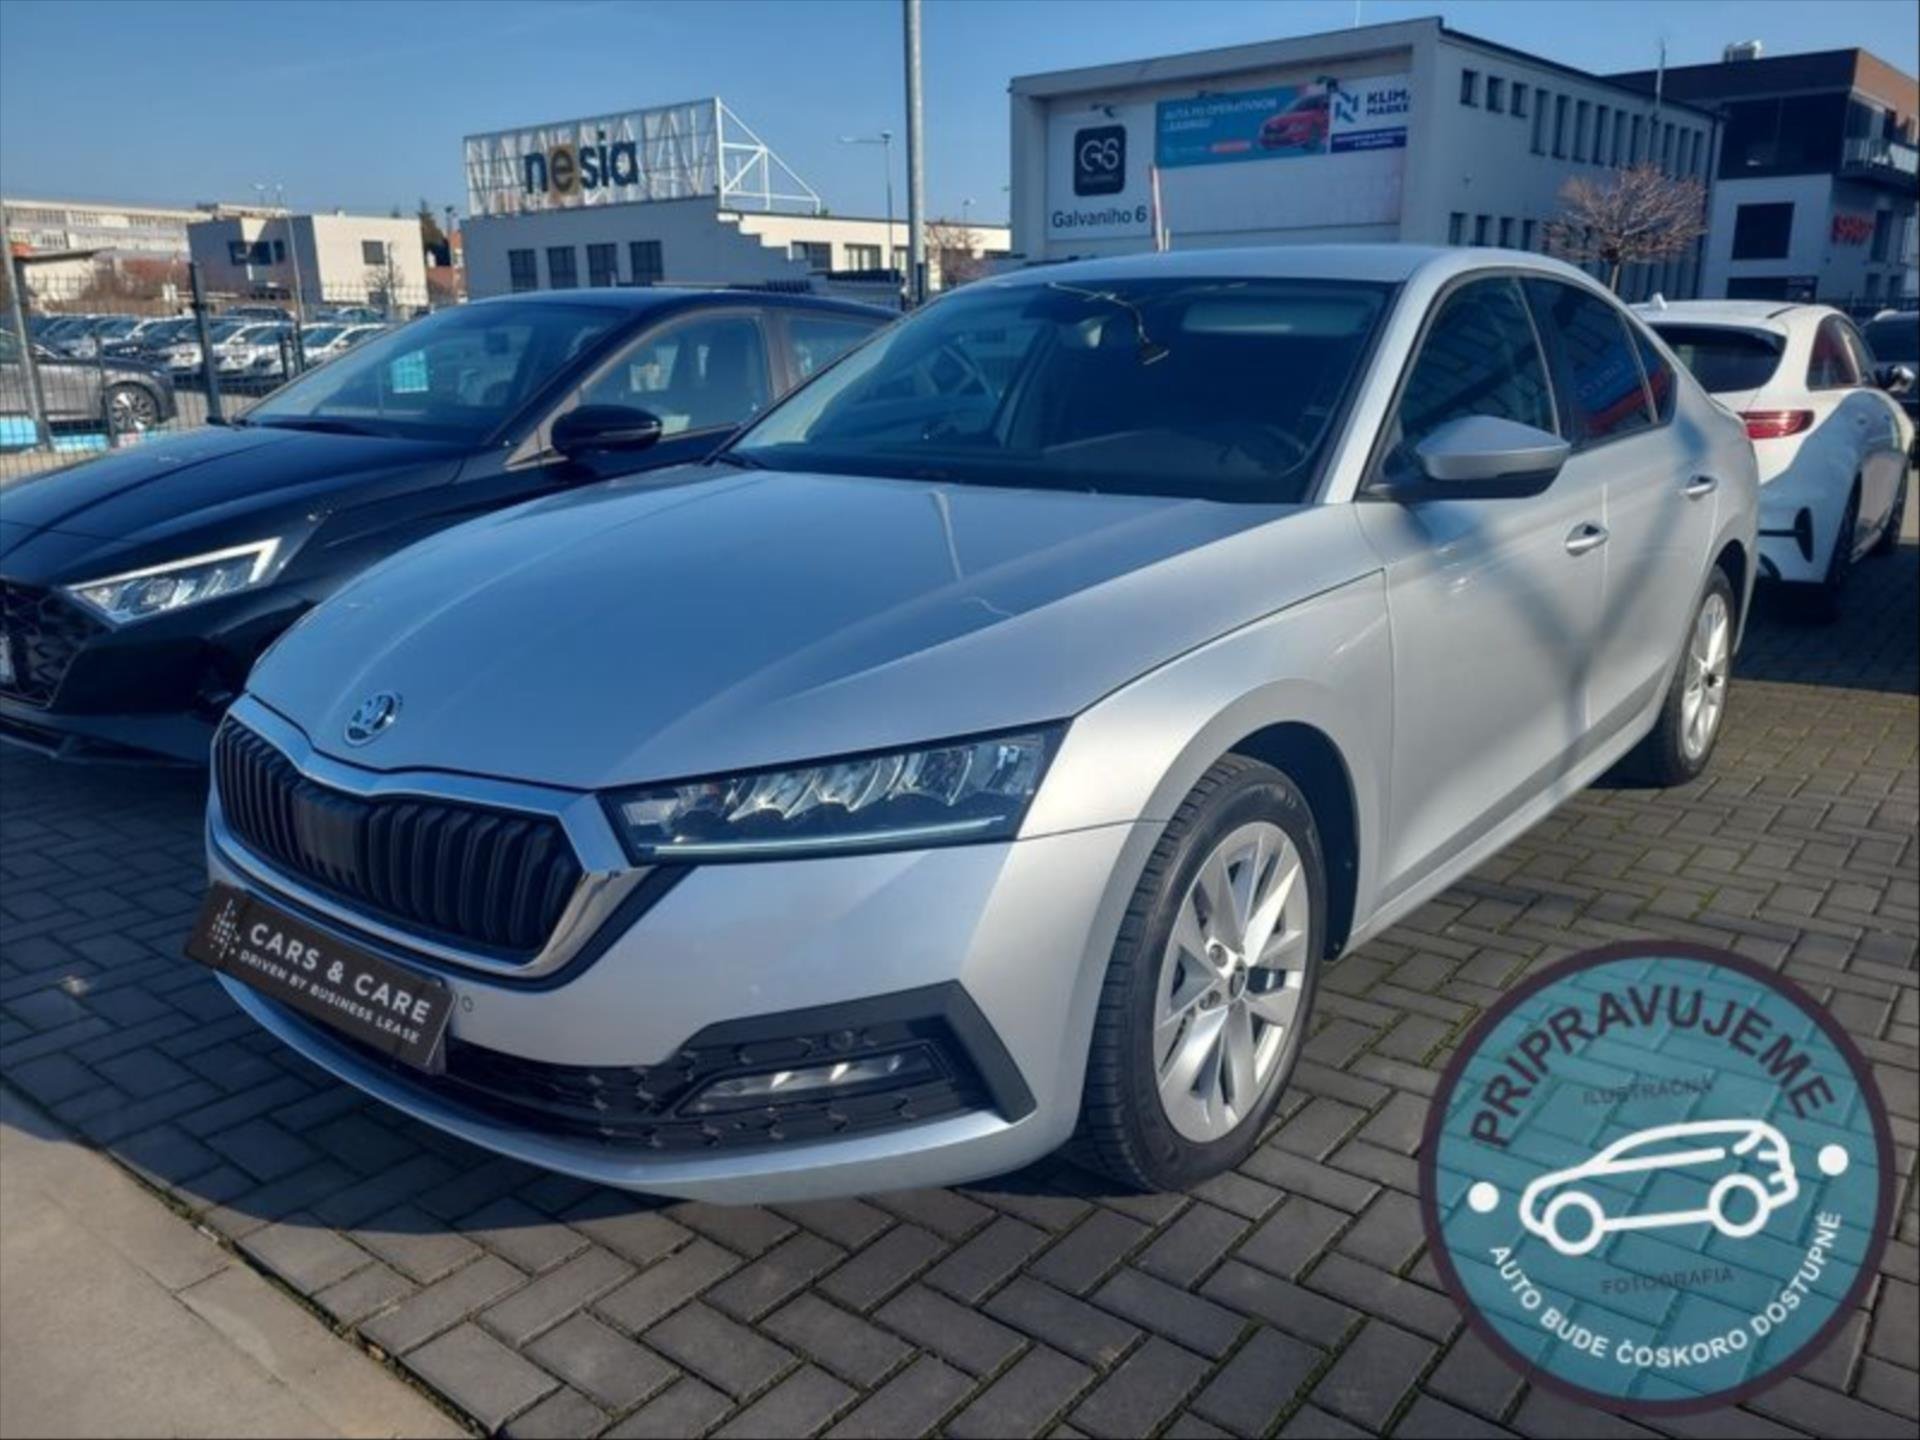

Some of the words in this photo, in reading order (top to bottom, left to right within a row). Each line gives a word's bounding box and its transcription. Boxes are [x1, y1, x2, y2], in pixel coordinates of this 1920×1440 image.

[1367, 89, 1411, 104] KLIM
[524, 130, 639, 194] nesia
[1053, 208, 1132, 228] Galvaniho
[1135, 205, 1147, 223] 6
[241, 949, 288, 980] DRIVEN
[289, 972, 308, 990] BY
[310, 983, 373, 1022] BUSINESS
[376, 1015, 420, 1044] LEASE
[250, 923, 319, 970] CARS
[327, 960, 344, 984] &
[354, 974, 431, 1023] CARE
